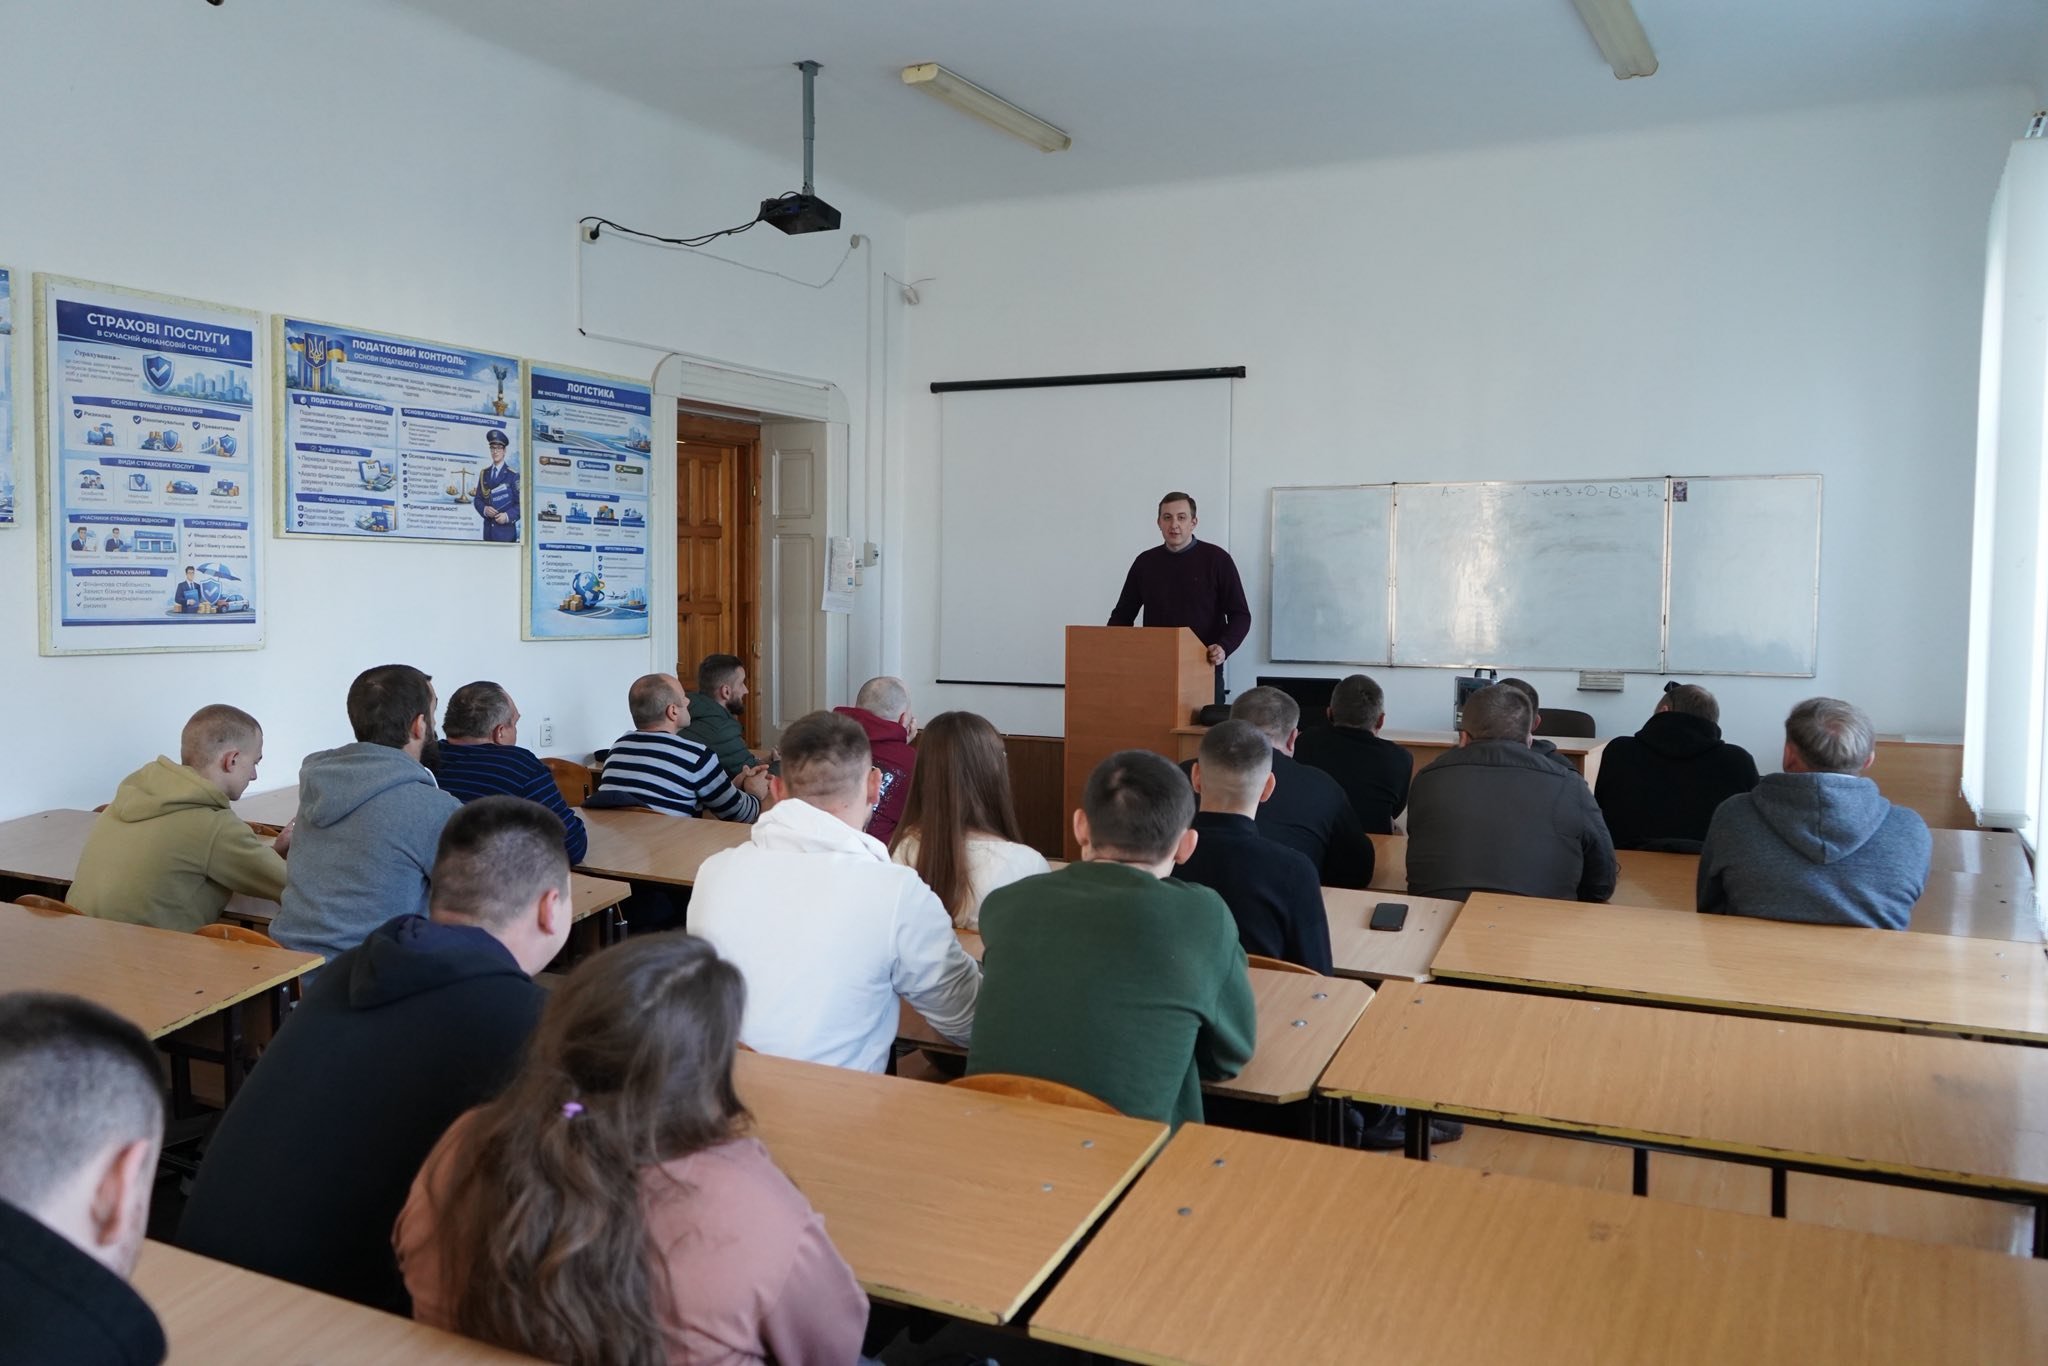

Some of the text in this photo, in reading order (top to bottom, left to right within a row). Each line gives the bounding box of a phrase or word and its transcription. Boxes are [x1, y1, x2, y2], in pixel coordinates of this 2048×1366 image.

[87, 312, 231, 346] СТРАХОВІ ПОСЛУГИ
[103, 331, 141, 342] СУЧАСНІЙ
[141, 336, 187, 349] ФІНАНСОВІЙ
[187, 343, 217, 354] СИСТЕМІ
[352, 339, 467, 366] ПОДАТКОВИЙ КОНТРОЛЬ:
[354, 353, 464, 376] ОСНОВИ ПОДАТКОВОГО ЗАКОНОДАВСТВА
[567, 382, 615, 399] ЛОГІСТИКА
[111, 399, 138, 408] ОСНОВНІ
[163, 405, 204, 414] СТРАХУВАННЯ
[310, 396, 386, 411] ПОДАТКОВИЙ КОНТРОЛЬ
[136, 460, 171, 469] СТРАХОВИХ
